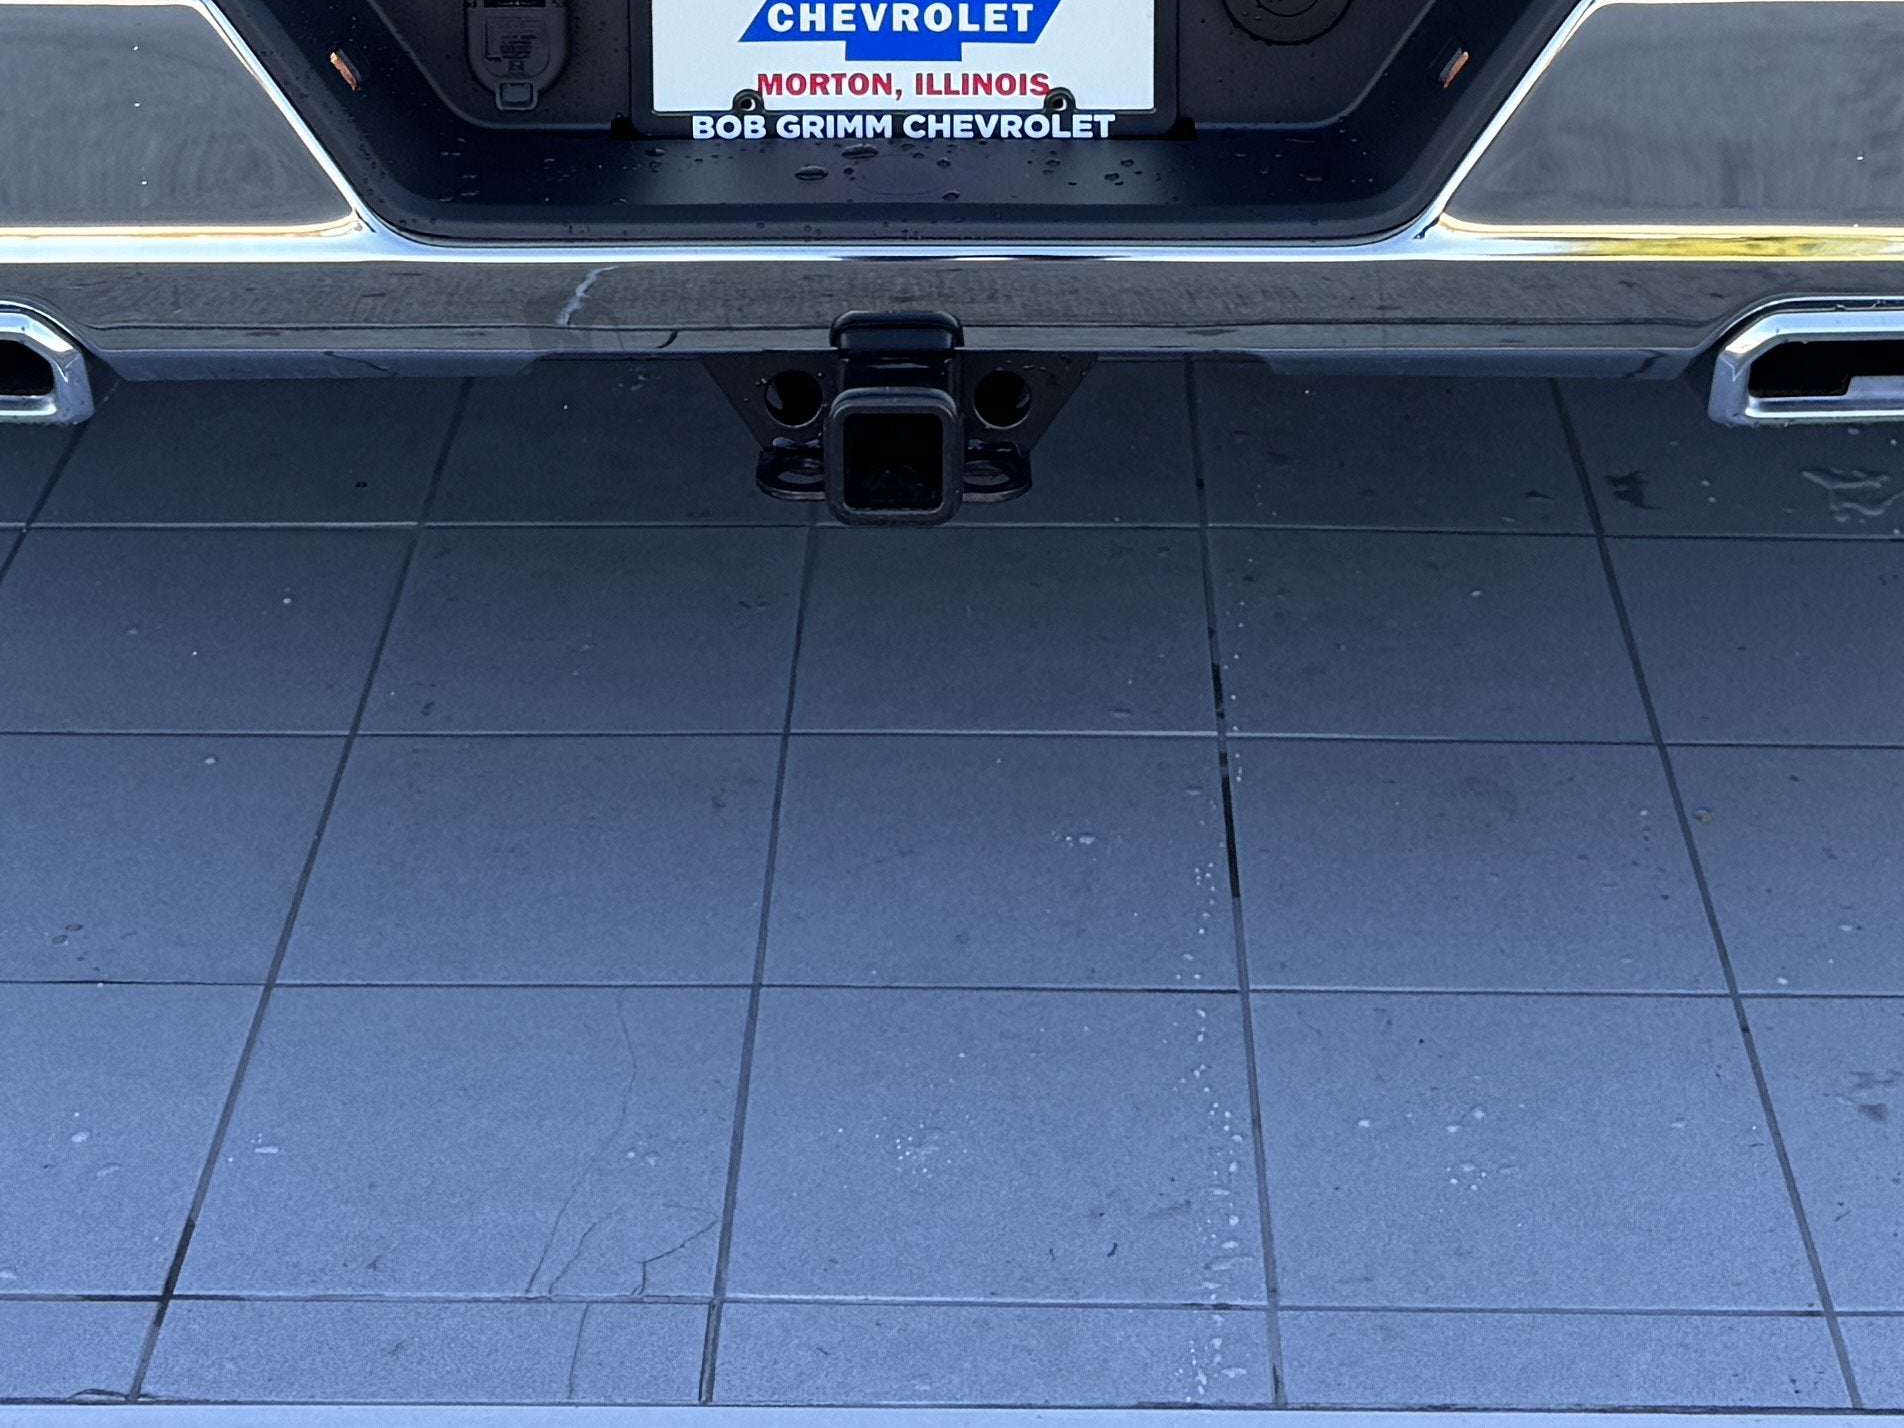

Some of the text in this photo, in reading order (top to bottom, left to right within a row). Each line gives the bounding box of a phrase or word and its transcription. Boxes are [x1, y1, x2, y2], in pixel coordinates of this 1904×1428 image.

[767, 2, 1034, 33] CHEVROLET
[757, 72, 1050, 101] MORTON, ILLINOIS
[692, 113, 1115, 139] BOB GRIMM CHEVROLET
